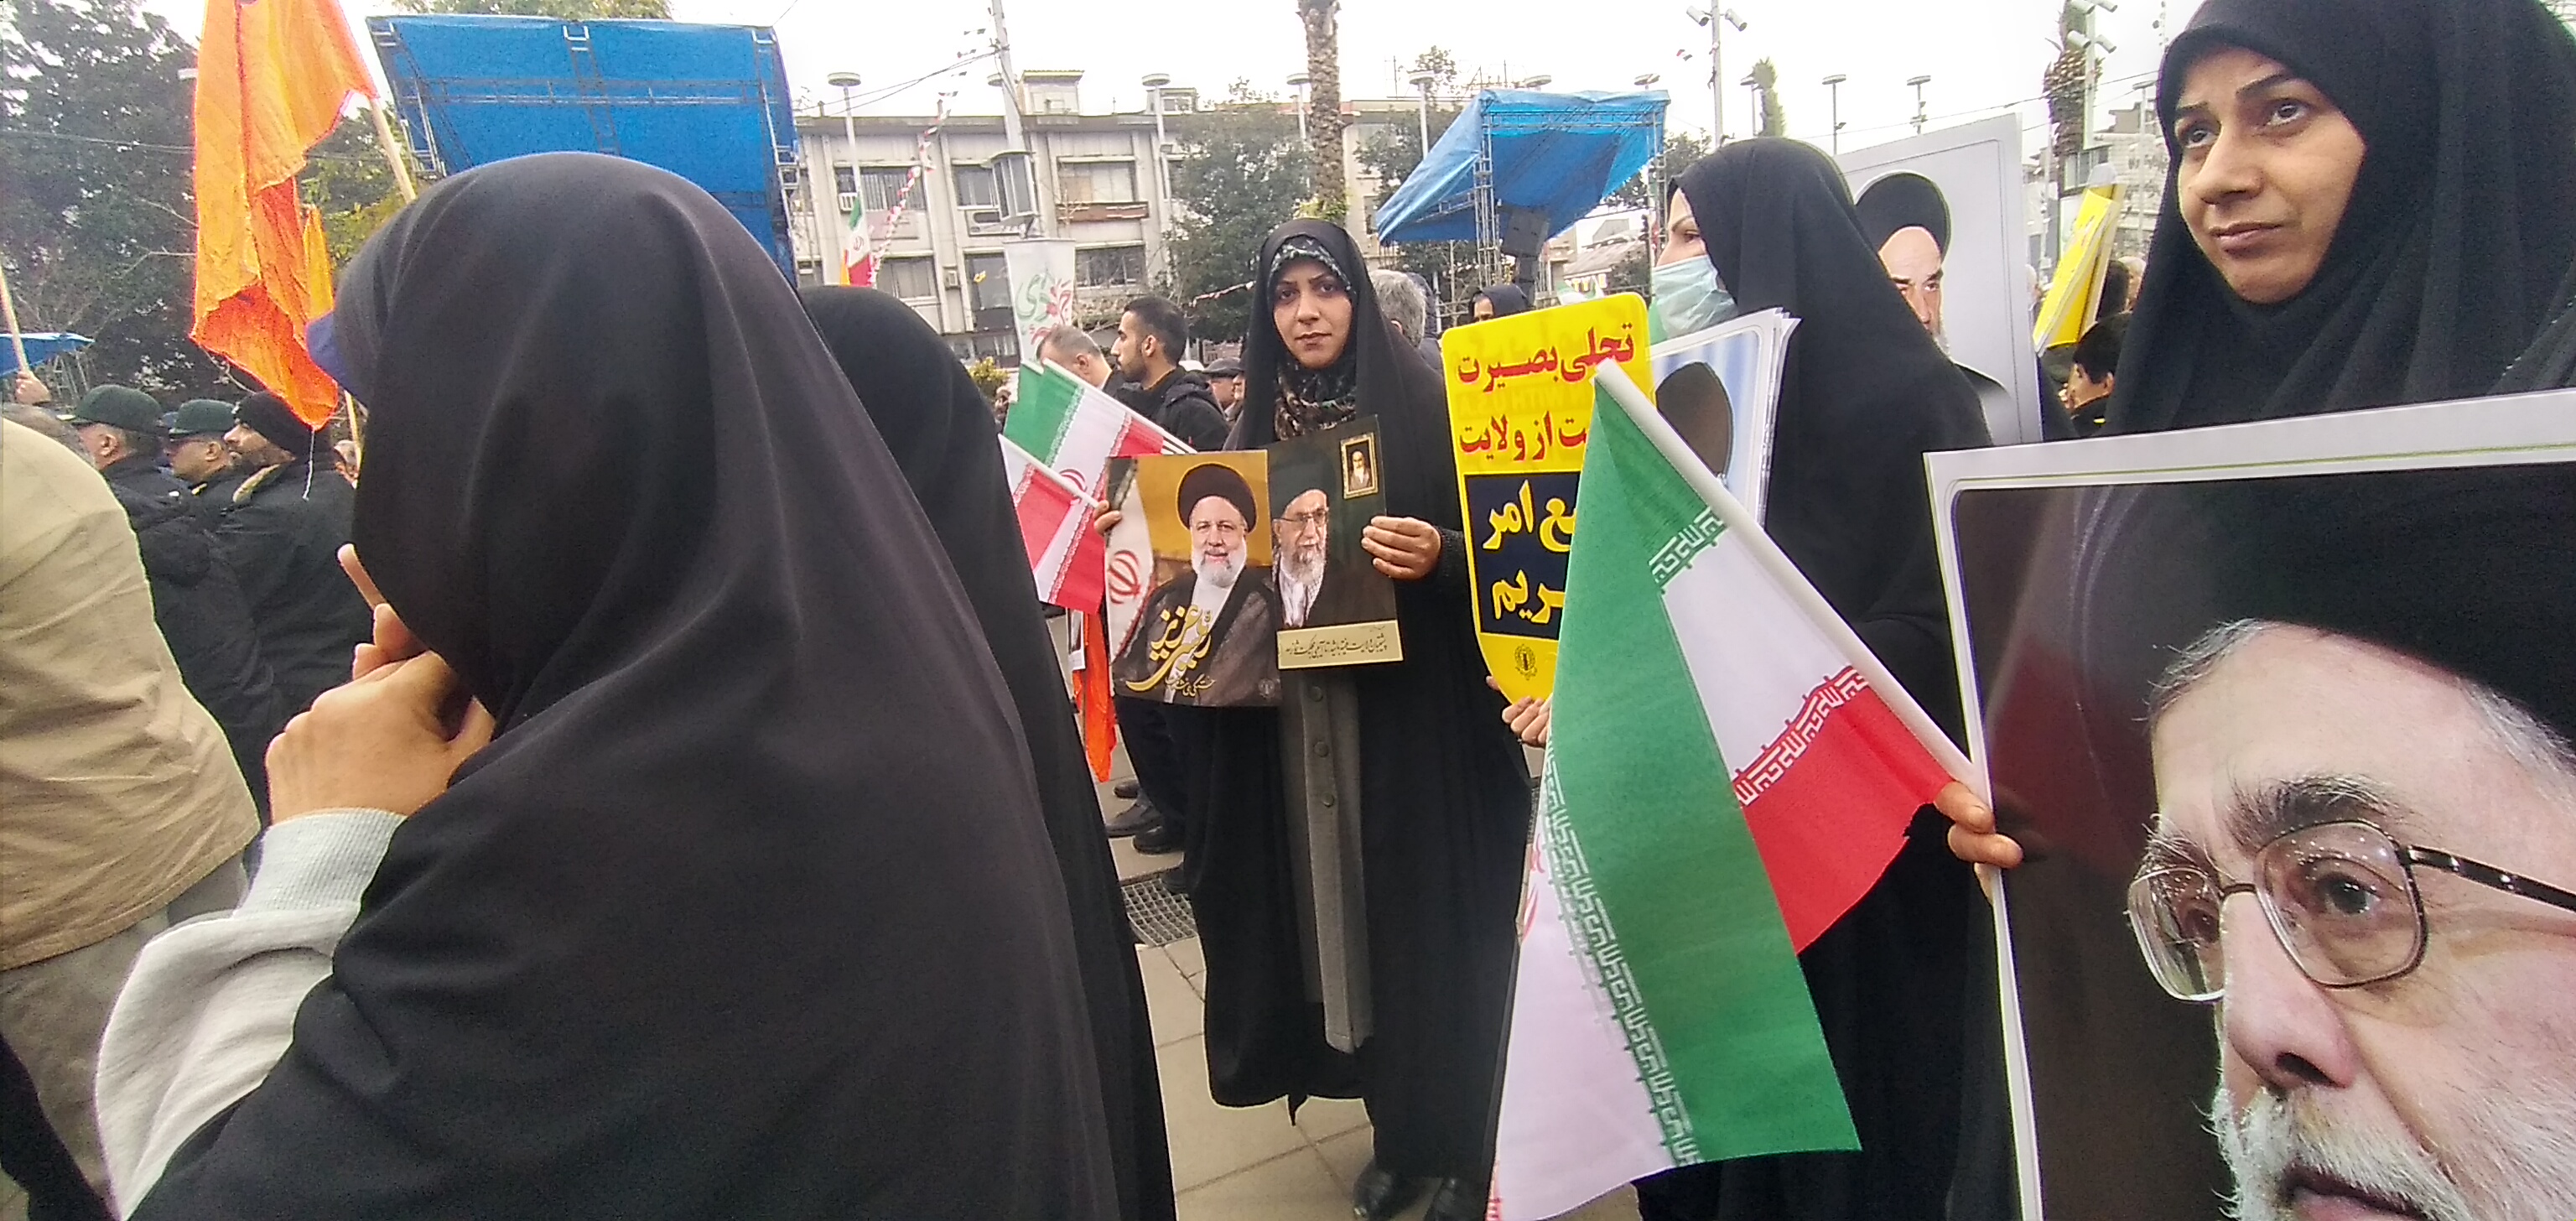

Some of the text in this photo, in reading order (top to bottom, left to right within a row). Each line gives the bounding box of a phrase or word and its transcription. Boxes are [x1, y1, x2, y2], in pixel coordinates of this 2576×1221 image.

[1457, 345, 1559, 392] بصیرت
[1459, 413, 1525, 461] ولایت
[1533, 411, 1552, 460] از
[1483, 479, 1534, 550] امر
